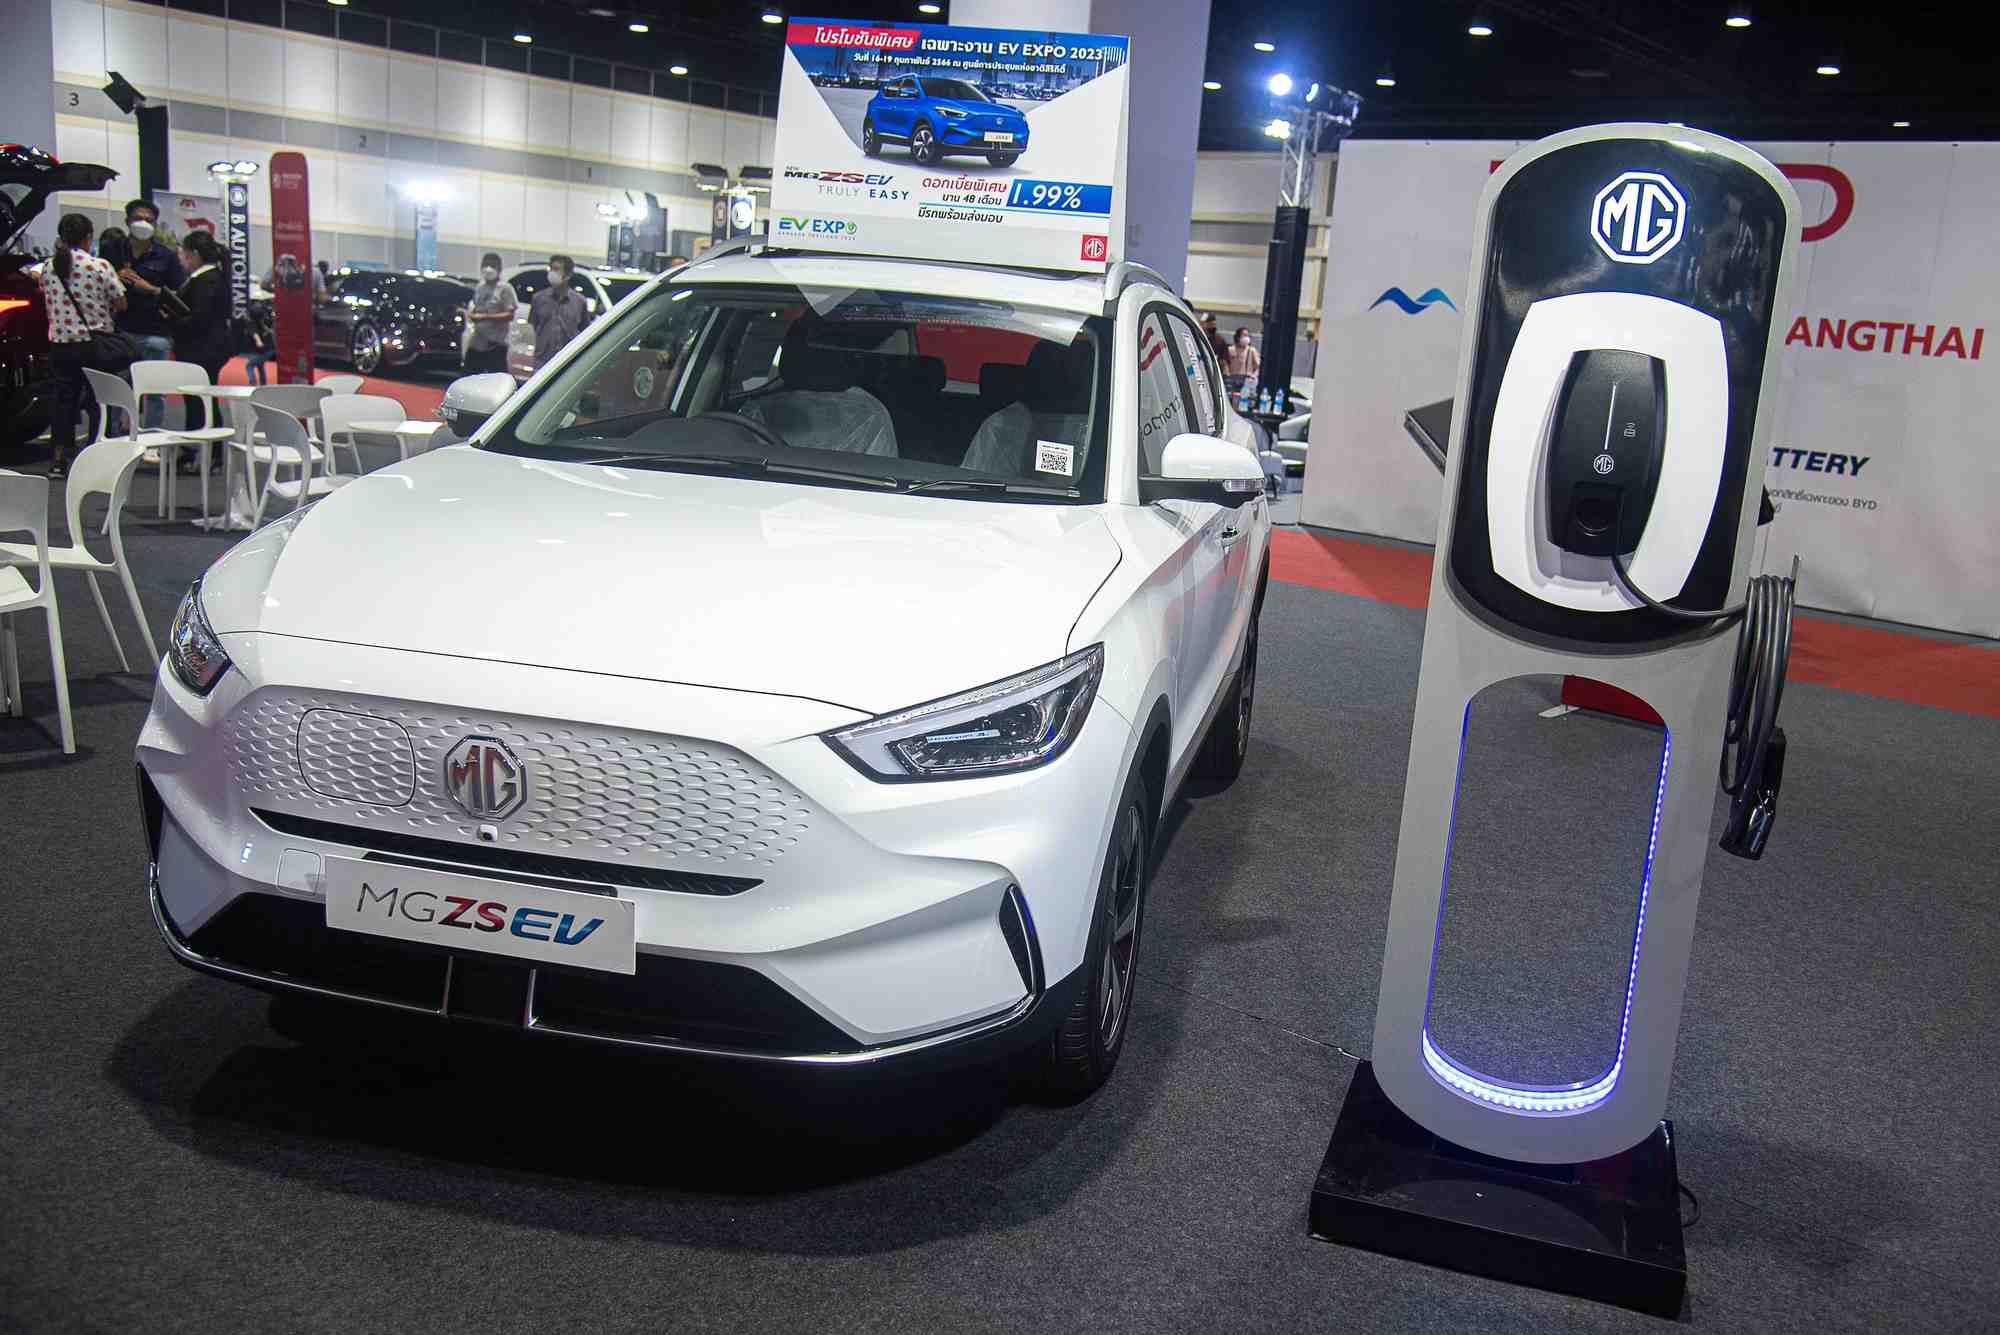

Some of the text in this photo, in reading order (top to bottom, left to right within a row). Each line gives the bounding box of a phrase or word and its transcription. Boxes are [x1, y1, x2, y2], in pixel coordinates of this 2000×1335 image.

[921, 38, 993, 54] เฉพาะงาน
[998, 42, 1020, 55] EV
[1022, 43, 1067, 58] EXPO
[1069, 47, 1103, 61] 2023
[871, 54, 893, 63] 16-19
[931, 58, 951, 67] 2566
[69, 92, 79, 106] 3
[817, 184, 911, 200] TRULY EASY
[921, 173, 1008, 193] ดอกเบี้ยพิเศษ
[942, 192, 1002, 207] นาน 48 เดือน
[1012, 183, 1084, 209] 1.99%
[779, 216, 810, 231] EV
[1600, 180, 1676, 254] MG
[1084, 238, 1105, 259] MG
[1784, 316, 1985, 361] ANGTHAI
[1594, 455, 1613, 473] MG
[1768, 446, 1871, 477] TTERY
[1852, 498, 1877, 511] BYD
[448, 742, 520, 817] MG
